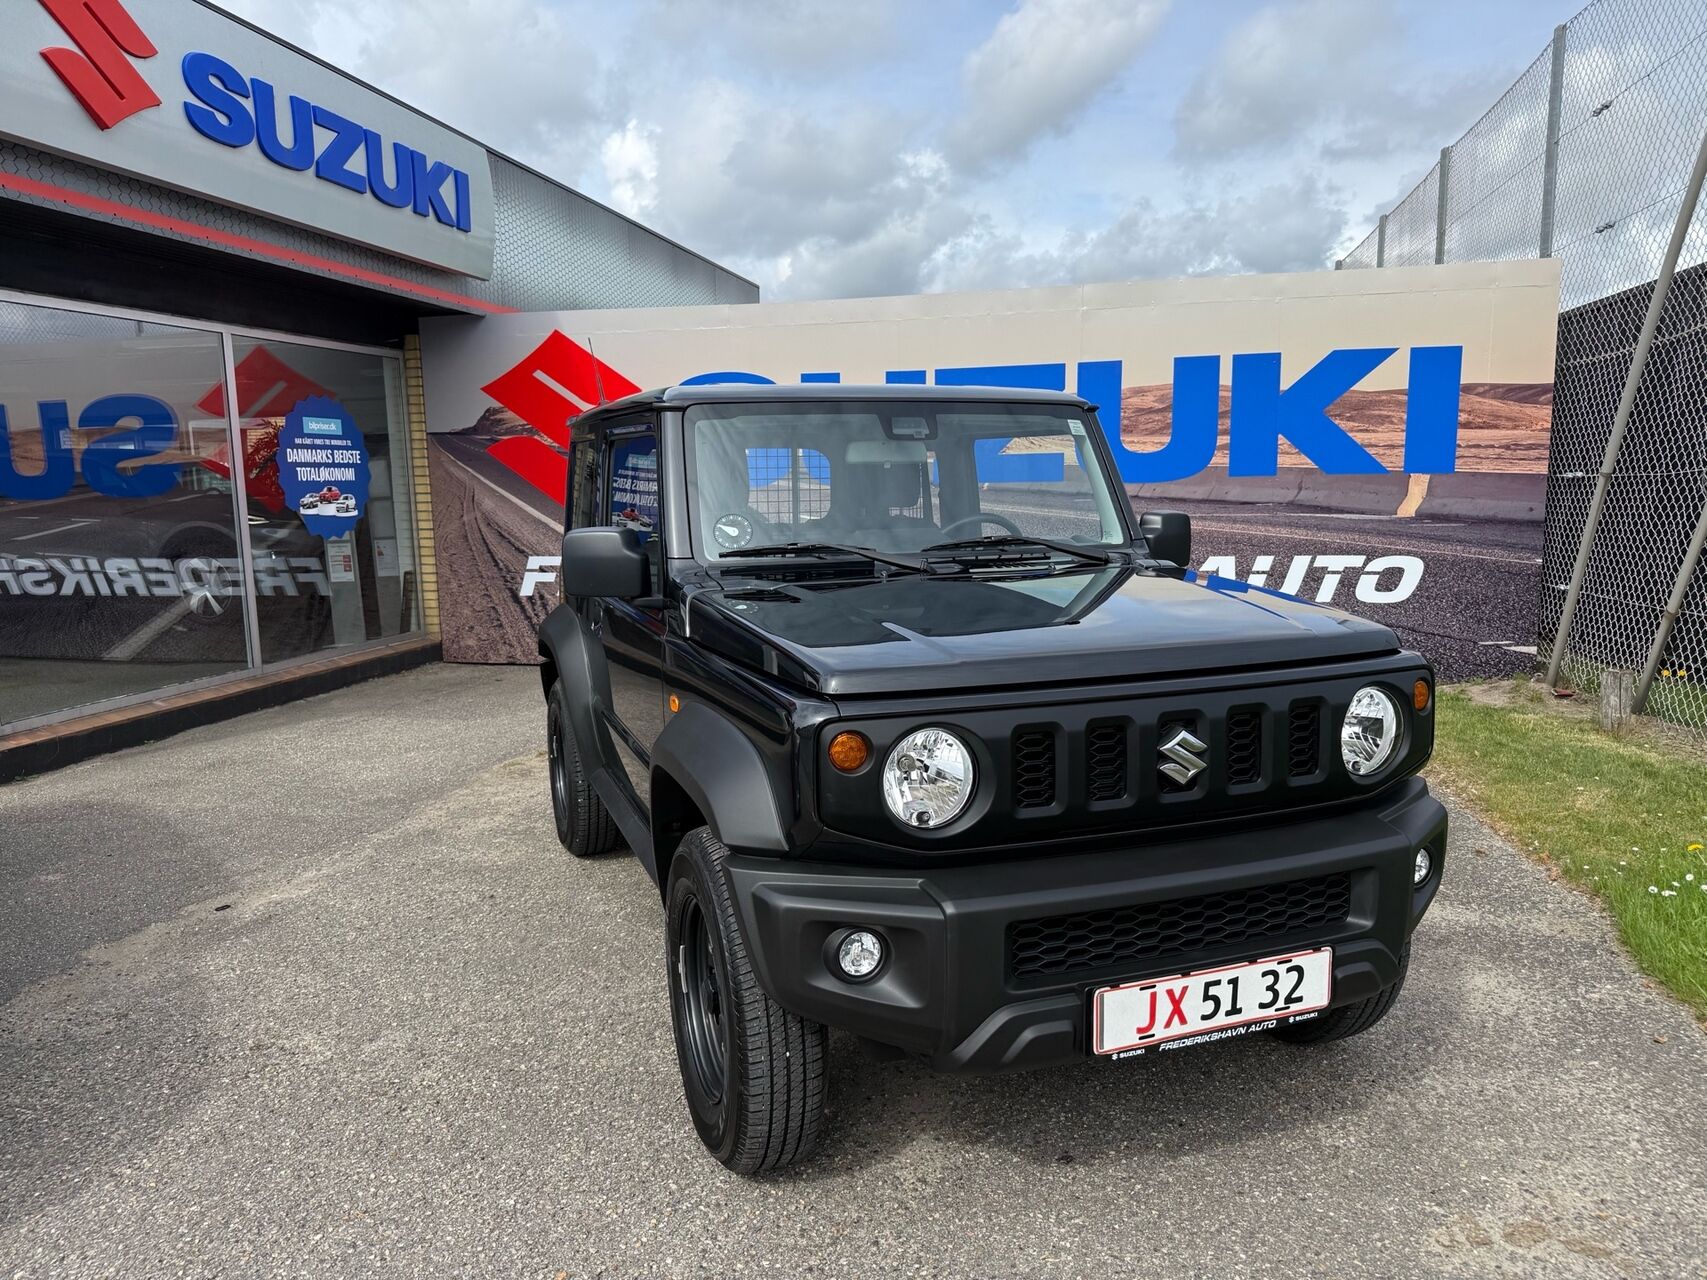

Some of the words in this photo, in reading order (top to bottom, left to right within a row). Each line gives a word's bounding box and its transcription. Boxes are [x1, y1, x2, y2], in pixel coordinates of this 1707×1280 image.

[181, 51, 471, 232] SUZUKI
[287, 448, 333, 463] DANMARKS
[334, 450, 361, 464] BEDSTE
[296, 466, 356, 482] TOTALØKONOMI
[1136, 985, 1189, 1034] JX
[1200, 976, 1242, 1021] 51
[1258, 964, 1305, 1010] 32
[1295, 1011, 1318, 1022] SUZUKI
[1159, 1026, 1247, 1051] FREDERIKSHAVN
[1248, 1020, 1277, 1033] AUTO
[1119, 1048, 1145, 1059] SUZUKI
